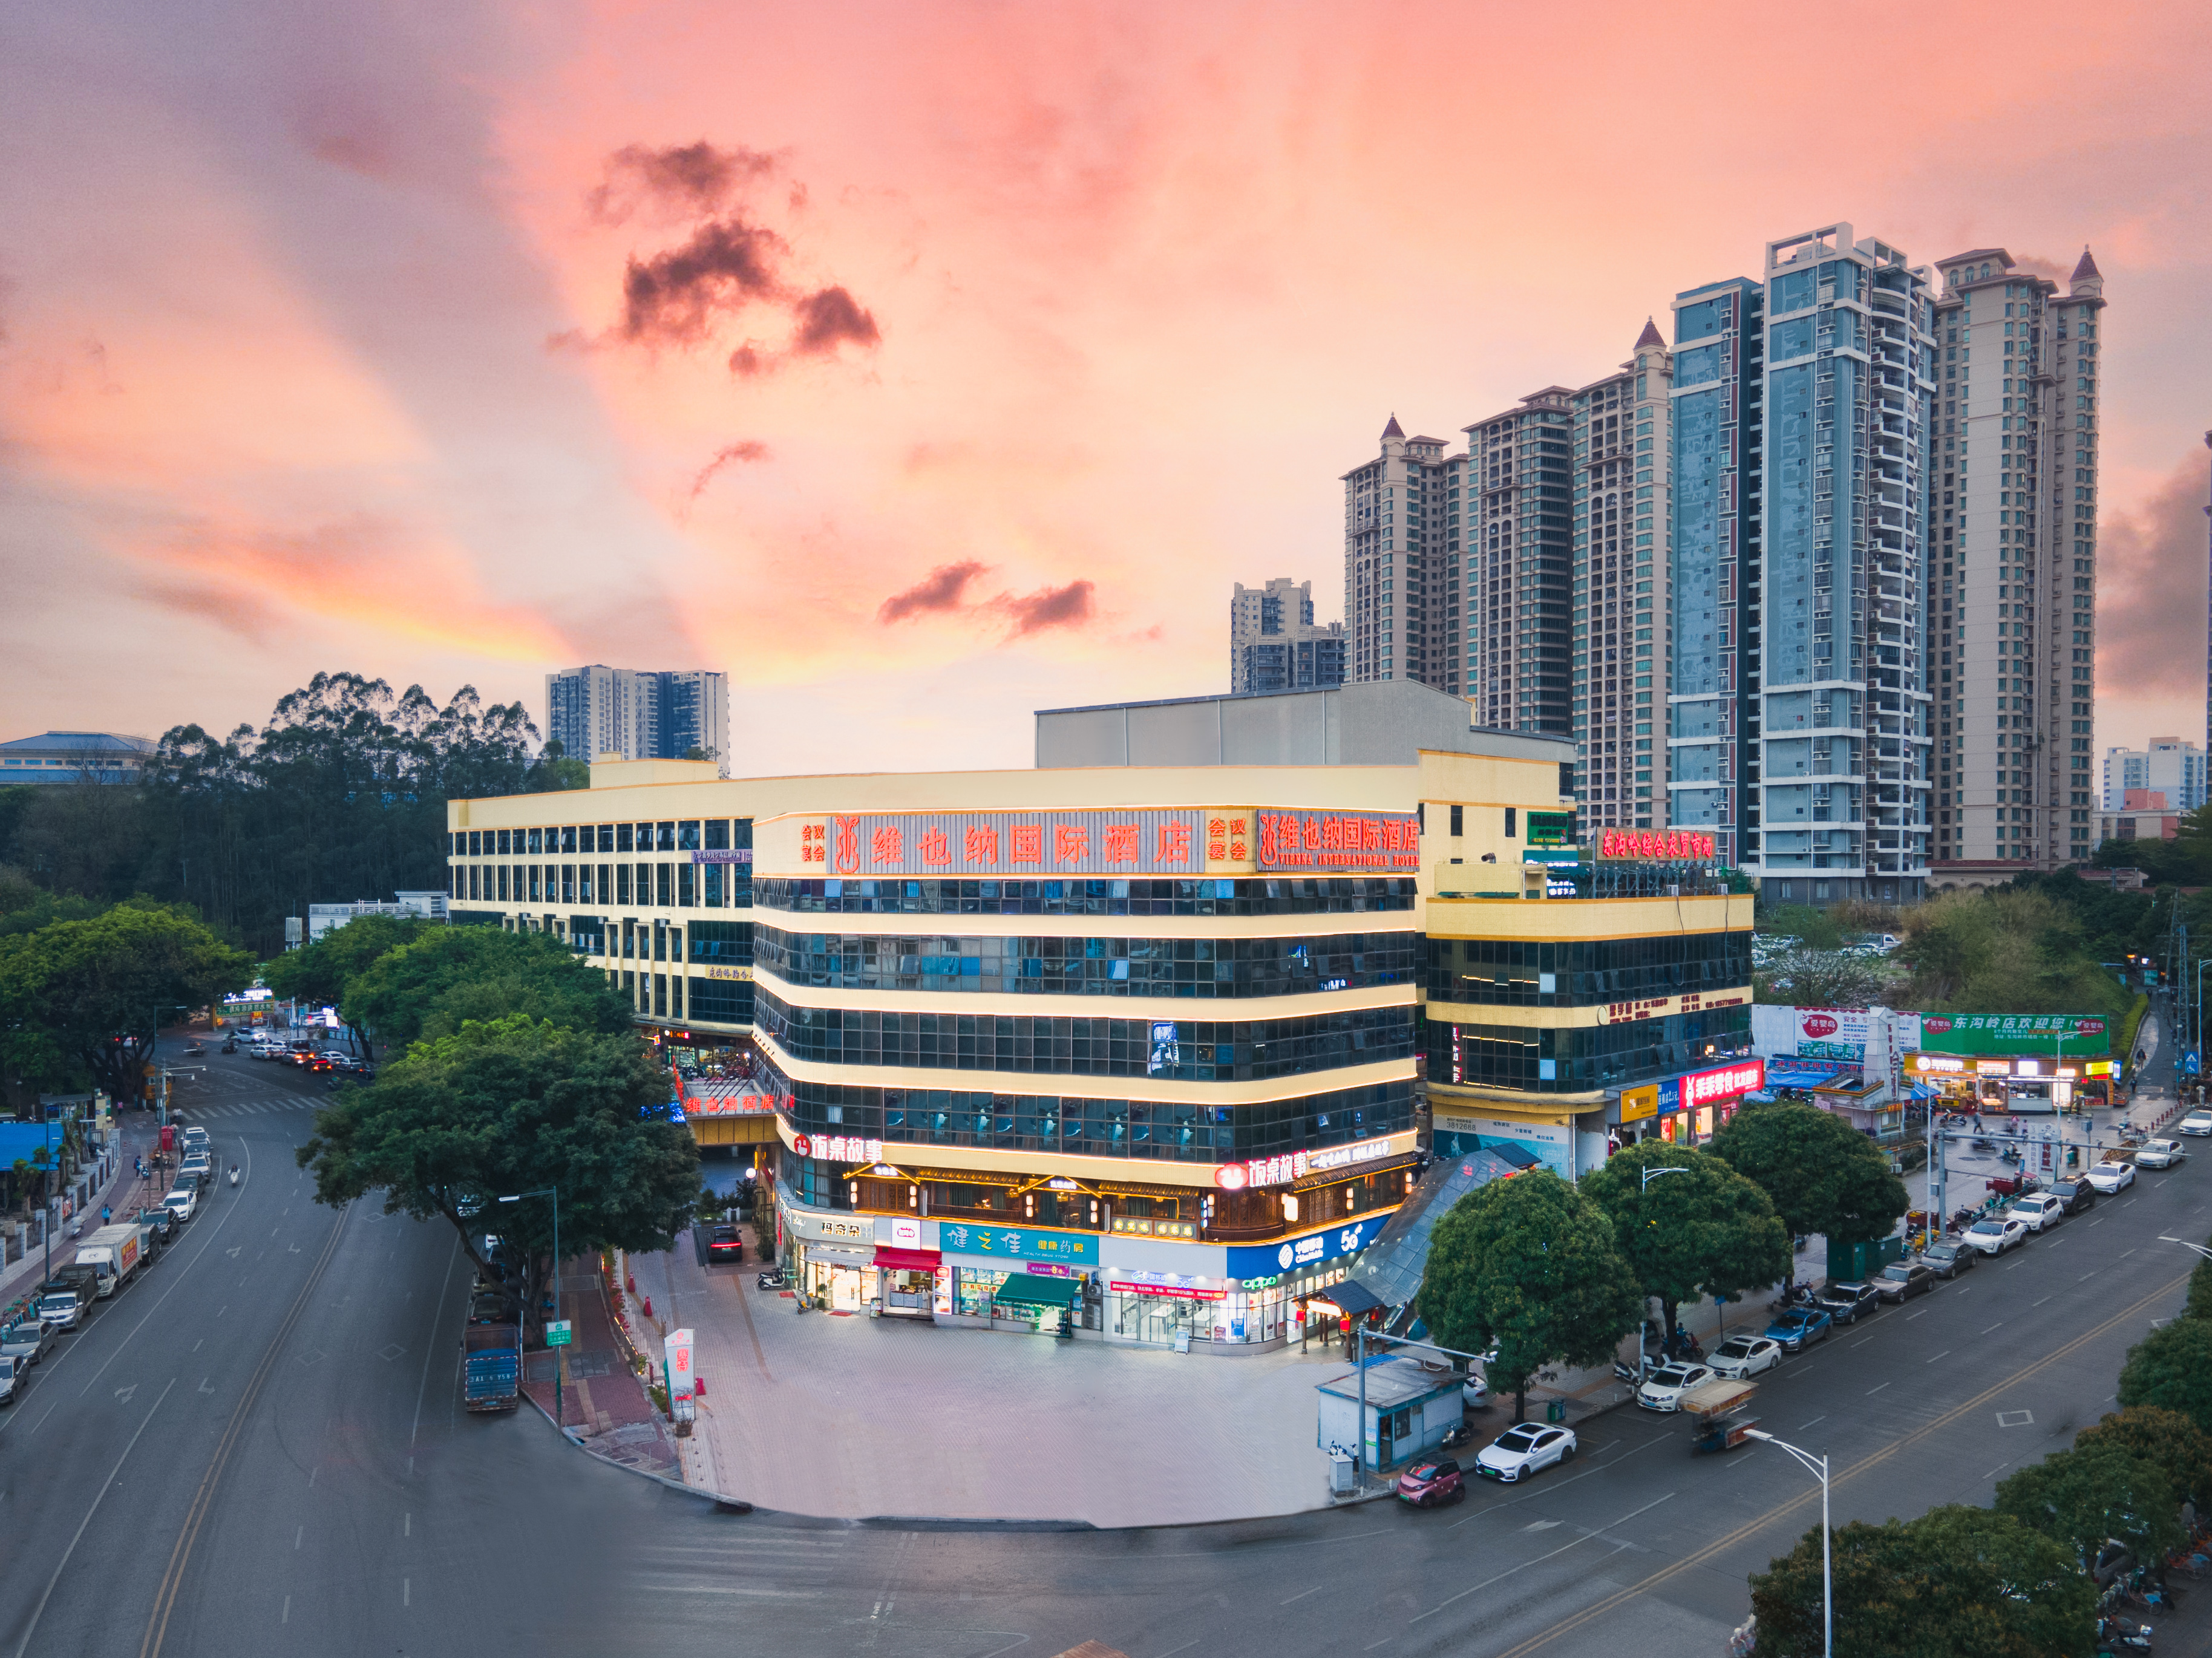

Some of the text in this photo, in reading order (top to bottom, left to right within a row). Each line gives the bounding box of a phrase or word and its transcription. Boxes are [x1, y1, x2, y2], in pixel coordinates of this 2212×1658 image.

[801, 824, 825, 840] 会议
[1208, 817, 1246, 837] 会议
[1278, 815, 1419, 852] 维也纳国际酒店
[871, 820, 1192, 866] 维也纳国际酒店
[1208, 841, 1247, 861] 宴会
[1603, 829, 1713, 858] 东沟岭综合农贸市场
[801, 844, 825, 863] 宴会
[1278, 853, 1419, 866] VIENNA INTERNATIONAL HOTEL
[1810, 1019, 1836, 1028] 爱婴岛
[687, 1094, 774, 1112] 维也纳酒店
[811, 1135, 882, 1164] 饭桌故事
[1248, 1152, 1307, 1187] 饭桌故事
[821, 1221, 862, 1237] 玛奇朵
[947, 1226, 1021, 1255] 健之佳
[1038, 1239, 1084, 1254] 健康药房
[1295, 1236, 1324, 1255] 中国移动
